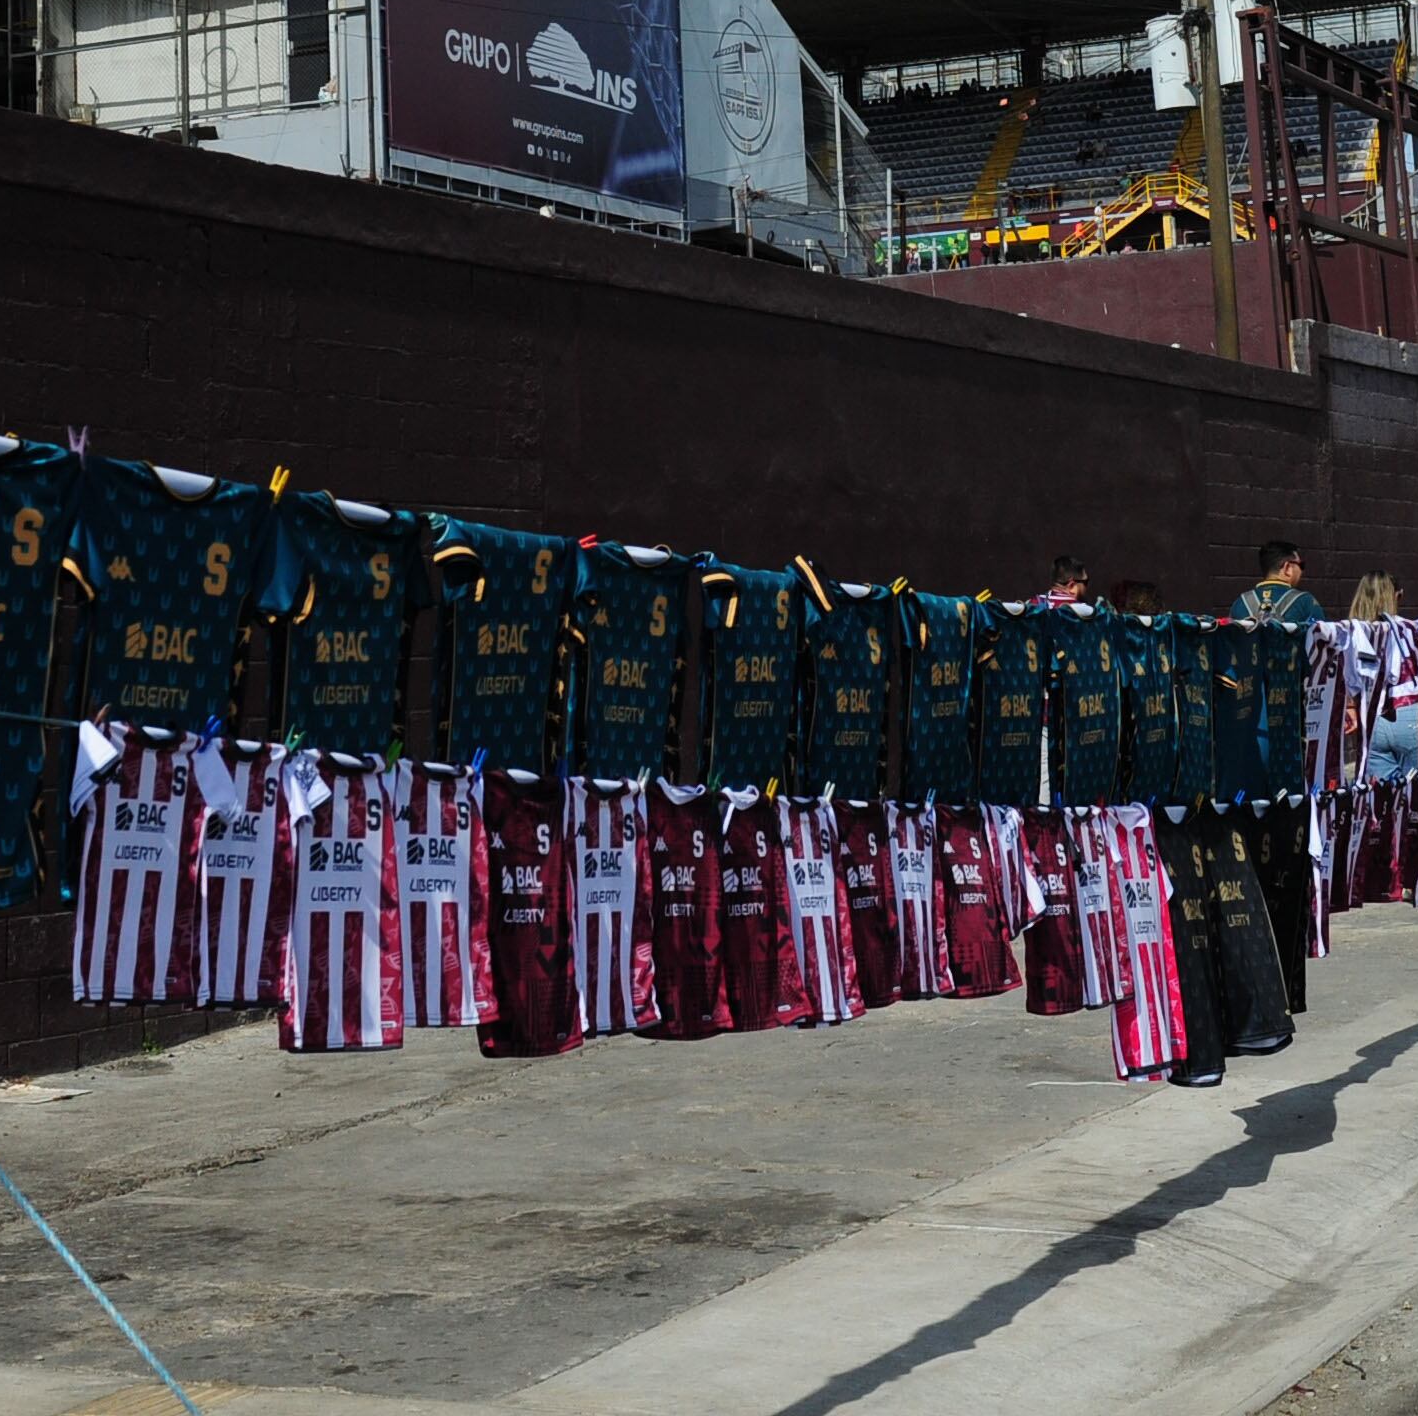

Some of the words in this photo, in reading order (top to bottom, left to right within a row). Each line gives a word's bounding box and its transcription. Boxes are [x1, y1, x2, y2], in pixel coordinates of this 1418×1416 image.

[445, 29, 511, 74] GRUPO
[595, 69, 637, 109] INS
[512, 117, 584, 144] www.grupoins.com
[11, 508, 44, 567] S
[203, 542, 231, 596] S
[369, 553, 391, 600] S
[532, 549, 553, 594] S
[649, 595, 668, 637] S
[776, 589, 790, 630] S
[956, 601, 969, 637] S
[151, 624, 196, 664] BAC
[333, 631, 370, 662] BAC
[496, 624, 529, 654] BAC
[867, 627, 881, 665] S
[1026, 639, 1038, 673] S
[1099, 640, 1110, 672] S
[620, 659, 649, 689] BAC
[751, 656, 776, 682] BAC
[120, 684, 190, 709] LIBERTY
[313, 684, 370, 704] LIBERTY
[476, 675, 525, 695] LIBERTY
[734, 700, 774, 718] LIBERTY
[850, 688, 871, 713] BAC
[1012, 694, 1031, 717] BAC
[1089, 693, 1105, 715] BAC
[603, 704, 645, 724] LIBERTY
[172, 766, 186, 797] S
[264, 777, 277, 807] S
[137, 804, 168, 826] BAC
[367, 799, 381, 831] S
[457, 801, 469, 829] S
[536, 823, 550, 855] S
[624, 814, 635, 842] S
[923, 825, 934, 847] S
[1293, 825, 1304, 854] S
[115, 845, 162, 862] LIBERTY
[333, 842, 363, 864] BAC
[429, 838, 456, 860] BAC
[692, 830, 705, 858] S
[755, 830, 767, 858] S
[820, 829, 831, 854] S
[867, 832, 878, 857] S
[969, 836, 982, 860] S
[1232, 830, 1246, 862] S
[1261, 832, 1271, 864] S
[206, 853, 255, 870] LIBERTY
[601, 851, 622, 871] BAC
[910, 849, 925, 869] BAC
[1055, 842, 1067, 867] S
[1145, 843, 1156, 872] S
[1192, 844, 1204, 878] S
[515, 865, 543, 888] BAC
[676, 865, 696, 886] BAC
[741, 866, 763, 885] BAC
[808, 862, 825, 880] BAC
[858, 864, 876, 880] BAC
[964, 864, 982, 881] BAC
[310, 886, 361, 902] LIBERTY
[410, 879, 456, 893] LIBERTY
[586, 889, 622, 905] LIBERTY
[664, 902, 696, 917] LIBERTY
[727, 901, 765, 917] LIBERTY
